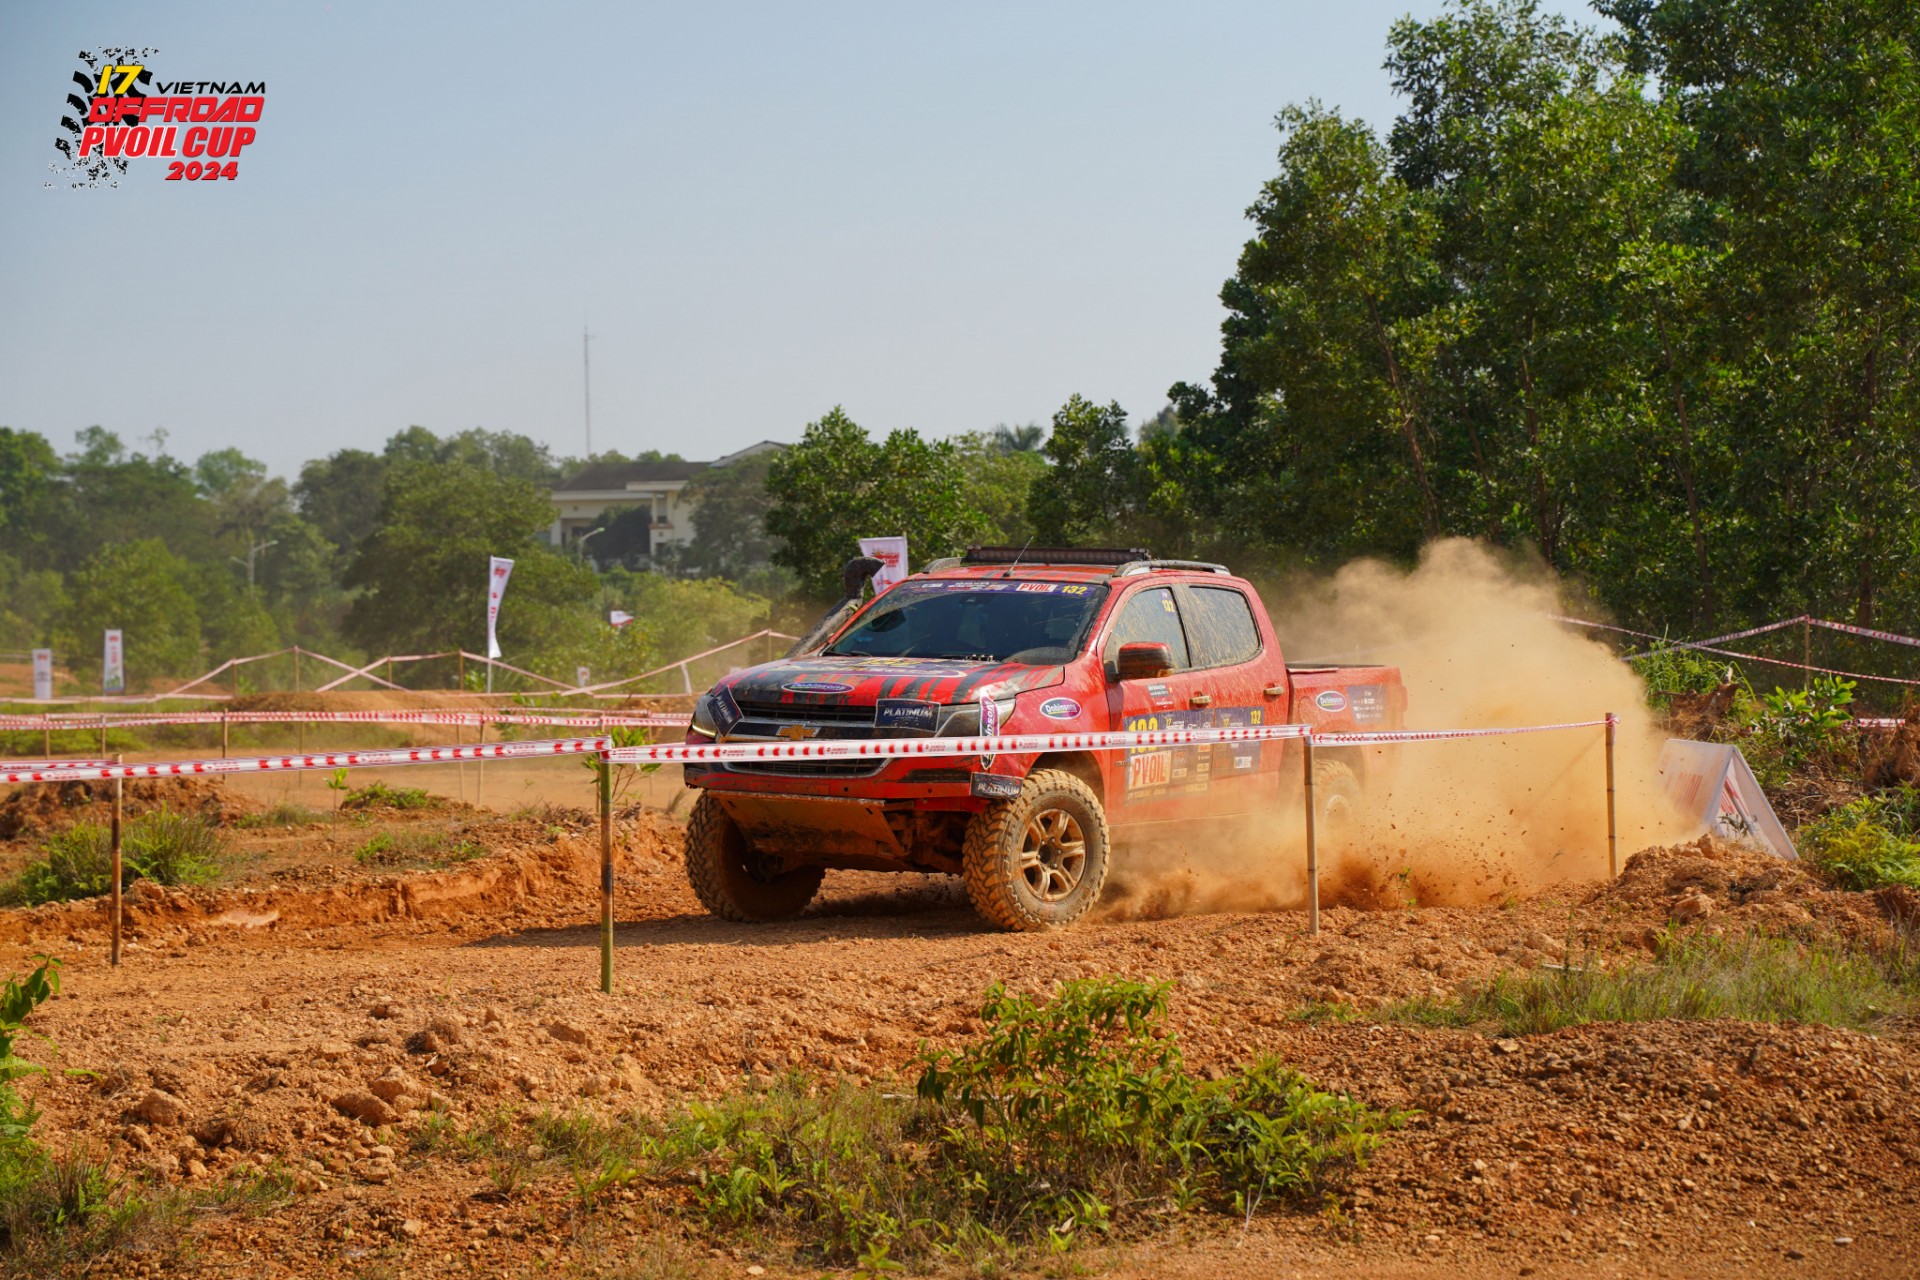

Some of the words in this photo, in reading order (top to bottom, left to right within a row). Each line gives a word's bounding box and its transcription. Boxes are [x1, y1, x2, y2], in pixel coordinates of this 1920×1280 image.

[1019, 583, 1051, 592] PVOIL
[1061, 585, 1088, 595] 132
[883, 706, 933, 719] PLATINUM
[1044, 703, 1078, 714] Dobinsons
[1130, 753, 1168, 788] PVOIL
